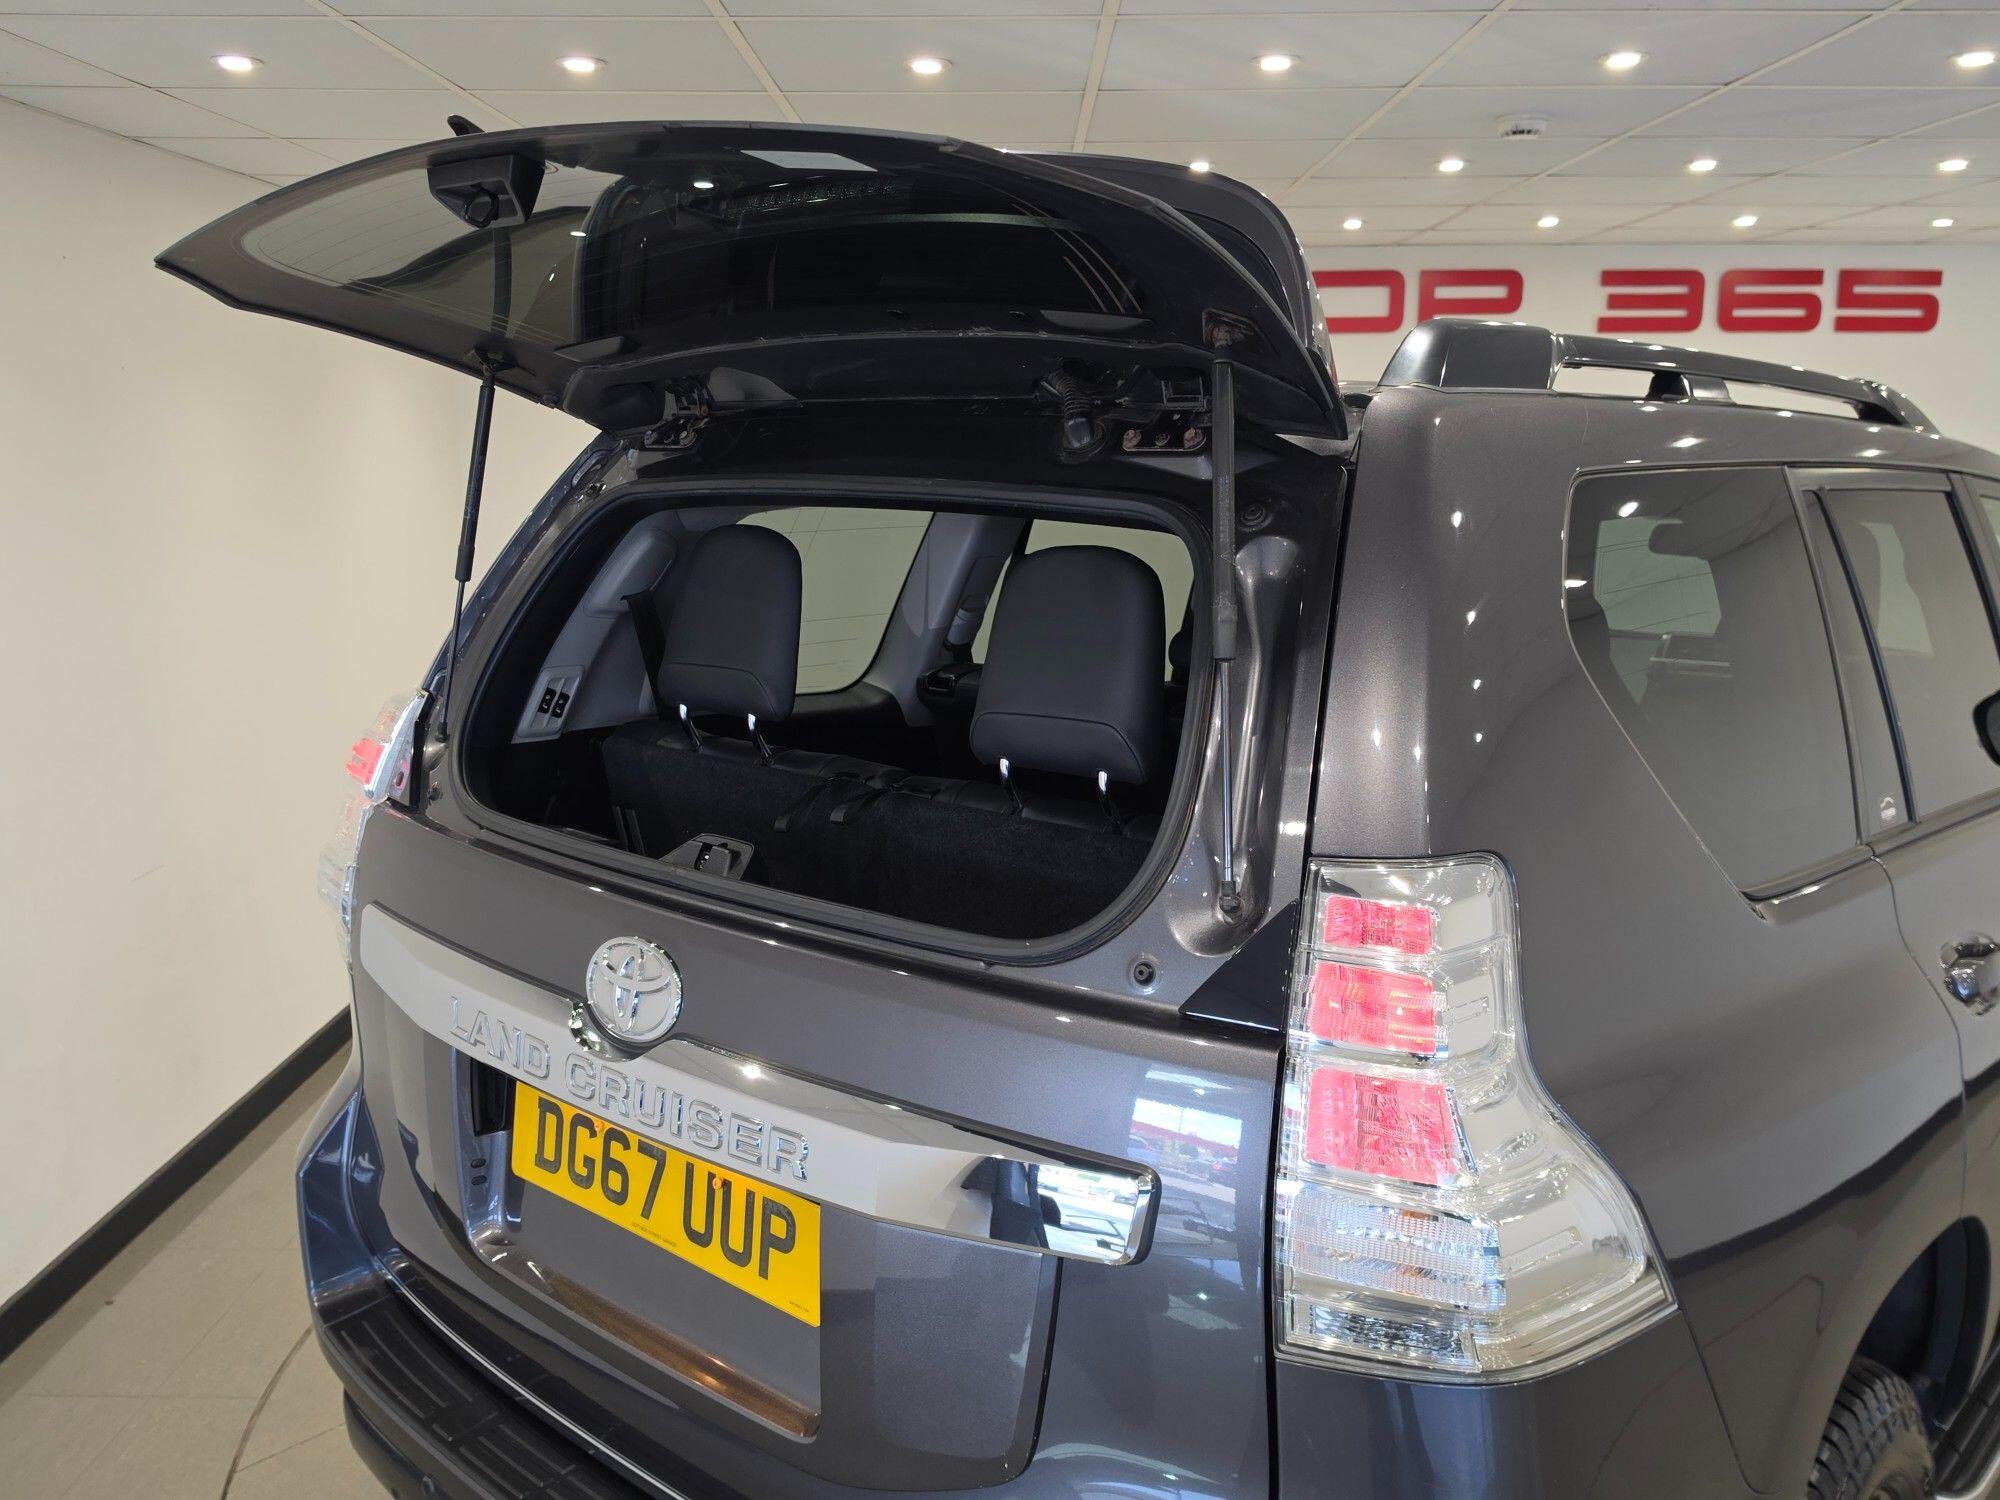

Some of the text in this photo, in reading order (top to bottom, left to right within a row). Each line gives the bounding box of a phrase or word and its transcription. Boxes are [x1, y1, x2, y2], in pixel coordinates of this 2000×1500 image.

[1597, 270, 1942, 332] 365
[449, 996, 810, 1182] LAND CRUISER
[534, 1097, 797, 1280] DG67 UUP
